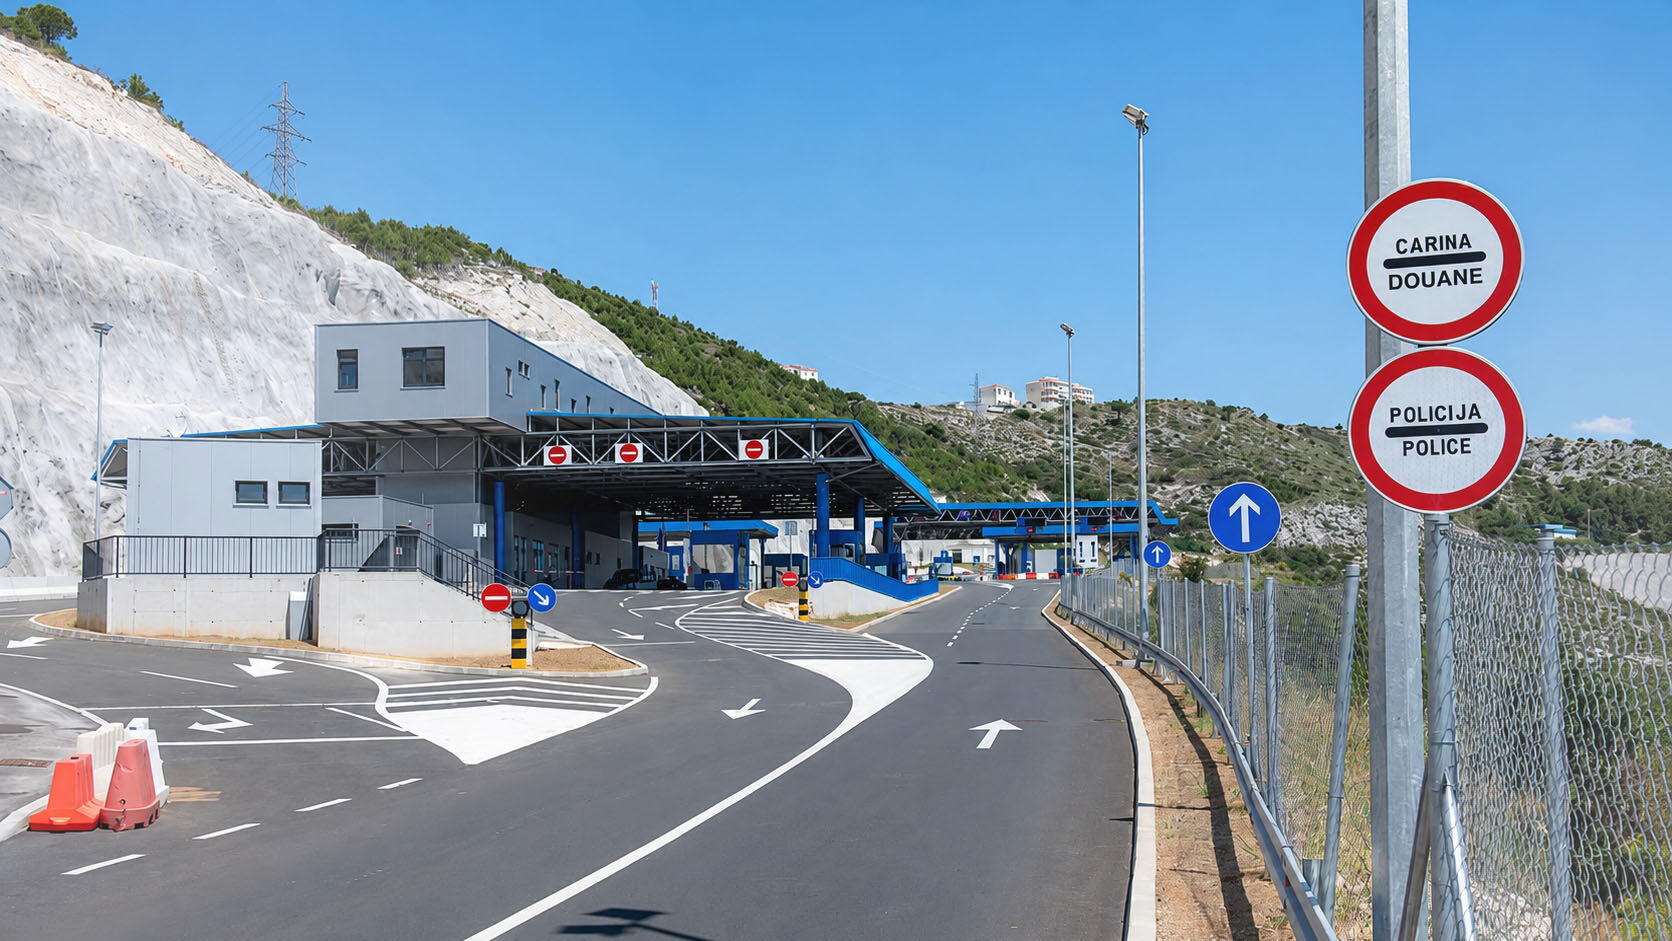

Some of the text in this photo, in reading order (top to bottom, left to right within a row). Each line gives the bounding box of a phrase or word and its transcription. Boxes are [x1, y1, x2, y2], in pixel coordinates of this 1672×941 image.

[1396, 234, 1471, 255] CARINA
[1389, 268, 1483, 290] DOUANE
[1390, 404, 1482, 423] POLICIJA
[1403, 438, 1471, 456] POLICE
